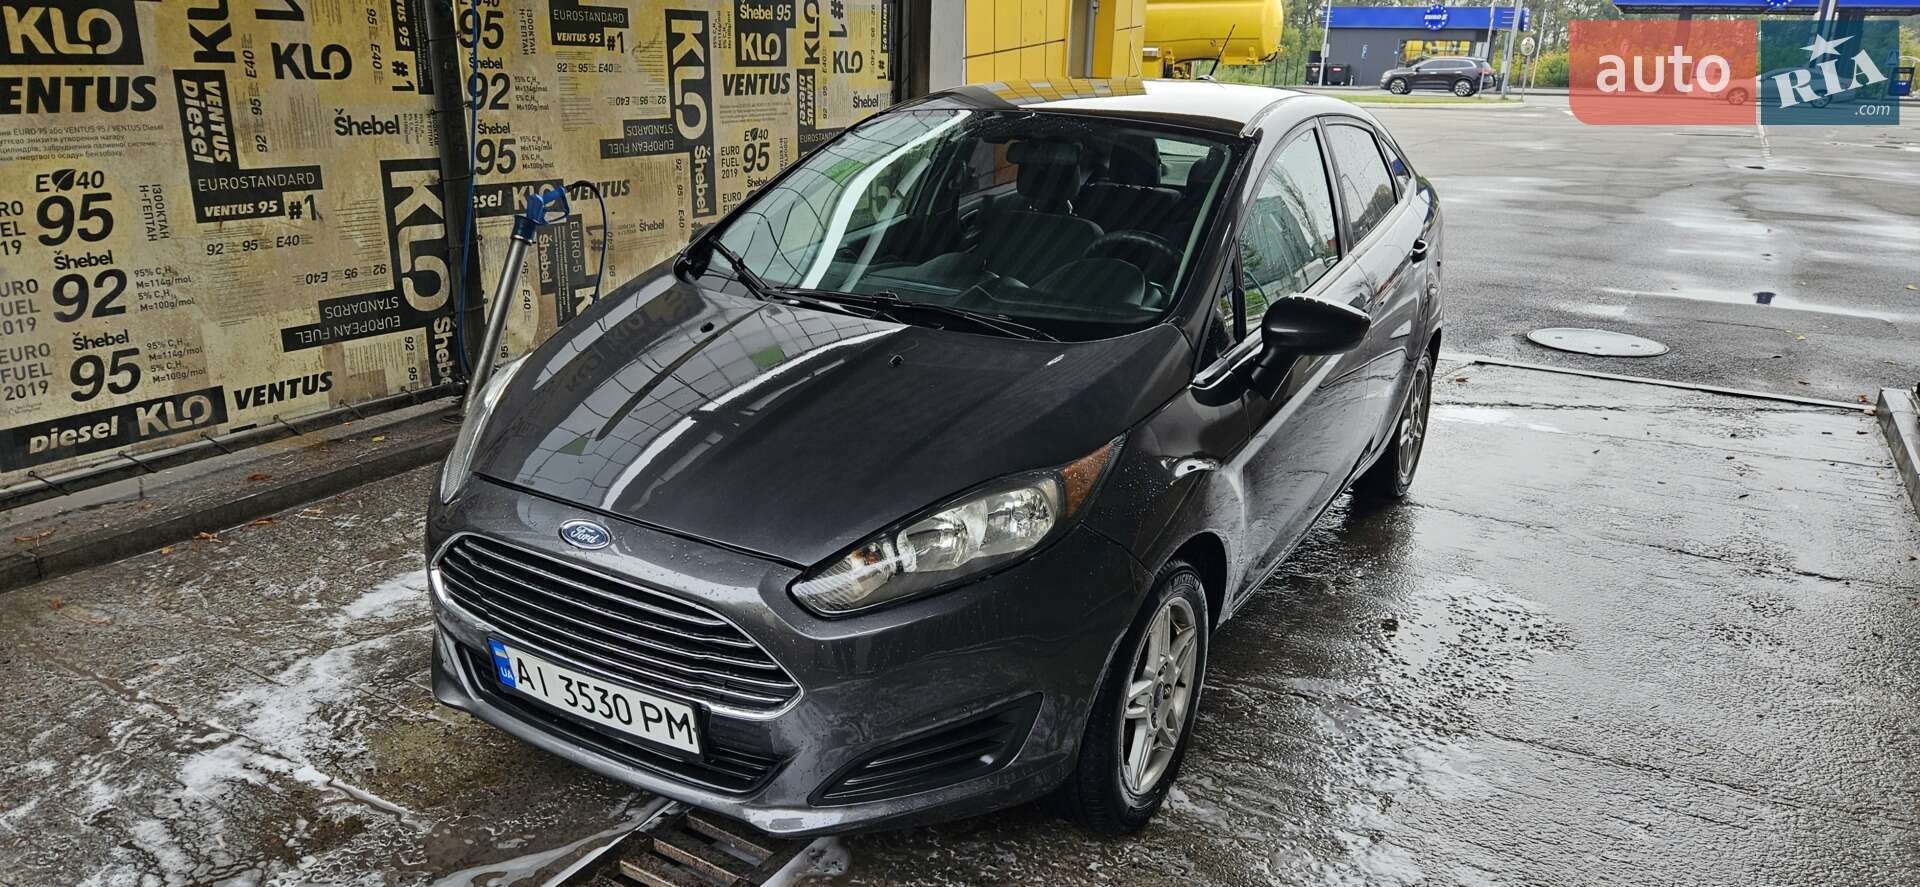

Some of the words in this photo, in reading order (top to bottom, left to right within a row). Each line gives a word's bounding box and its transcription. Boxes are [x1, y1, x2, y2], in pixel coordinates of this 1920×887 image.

[553, 9, 625, 24] EUROSTANDARD
[740, 0, 774, 21] Šhebel
[776, 4, 792, 21] 95
[3, 6, 123, 54] KLO
[399, 26, 411, 47] 95
[459, 8, 504, 50] 95
[803, 0, 820, 65] KLO
[556, 32, 587, 42] VENTUS
[589, 32, 601, 44] 95
[607, 31, 625, 54] #1
[741, 32, 782, 61] KLO
[242, 50, 258, 79] E40
[271, 42, 352, 80] KLO
[370, 43, 383, 70] E40
[557, 62, 568, 73] 92
[578, 62, 589, 73] 95
[598, 62, 614, 73] E40
[832, 50, 864, 74] KLO
[392, 60, 415, 92] #1
[671, 19, 708, 140] KLO
[722, 72, 791, 97] VENTUS
[467, 72, 511, 111] 92
[615, 96, 630, 106] E40
[799, 75, 808, 126] Diesel
[806, 75, 815, 127] VENTUS
[852, 90, 879, 110] Šhebel
[251, 98, 263, 116] 95
[181, 79, 214, 164] Diesel
[204, 80, 232, 163] VENTUS
[334, 107, 400, 137] Šhebel
[477, 119, 511, 135] Šhebel
[626, 123, 673, 136] STANDARDS
[255, 134, 268, 153] 92
[608, 143, 630, 154] FUEL
[632, 140, 674, 152] EUROPEAN
[720, 145, 740, 157] EURO
[475, 138, 517, 176] 95
[721, 157, 740, 168] FUEL
[743, 142, 770, 174] 95
[198, 172, 315, 192] EUROSTANDARD
[694, 145, 711, 214] Šhebel
[721, 168, 738, 179] 2019
[204, 203, 254, 218] VENTUS
[258, 200, 278, 213] 95
[288, 194, 317, 221] #1
[722, 191, 742, 203] EURO
[36, 192, 114, 247] 95
[639, 219, 665, 233] Šhebel
[678, 209, 686, 229] E40
[207, 243, 224, 256] 92
[242, 239, 258, 251] 95
[276, 234, 300, 248] E40
[390, 169, 450, 311] KLO
[570, 221, 583, 273] EURO-5
[54, 250, 114, 271] Šhebel
[539, 233, 553, 284] Šhebel
[305, 271, 328, 285] E40
[344, 267, 358, 279] 95
[373, 264, 387, 276] 92
[52, 268, 128, 323] 92
[522, 289, 532, 311] E40
[325, 296, 399, 319] STANDARDS
[296, 326, 330, 344] FUEL
[334, 315, 401, 337] EUROPEAN
[73, 329, 129, 351] Šhebel
[404, 336, 415, 352] 92
[0, 362, 53, 384] FUEL
[69, 348, 141, 403] 95
[408, 366, 418, 381] 95
[5, 380, 49, 401] 2019
[29, 415, 119, 454] Diesel
[136, 395, 212, 437] KLO
[234, 371, 333, 411] VENTUS
[571, 525, 600, 544] Ford
[500, 667, 514, 680] UA
[516, 656, 549, 697] AI
[558, 674, 633, 726] 3530
[639, 700, 694, 745] PM
